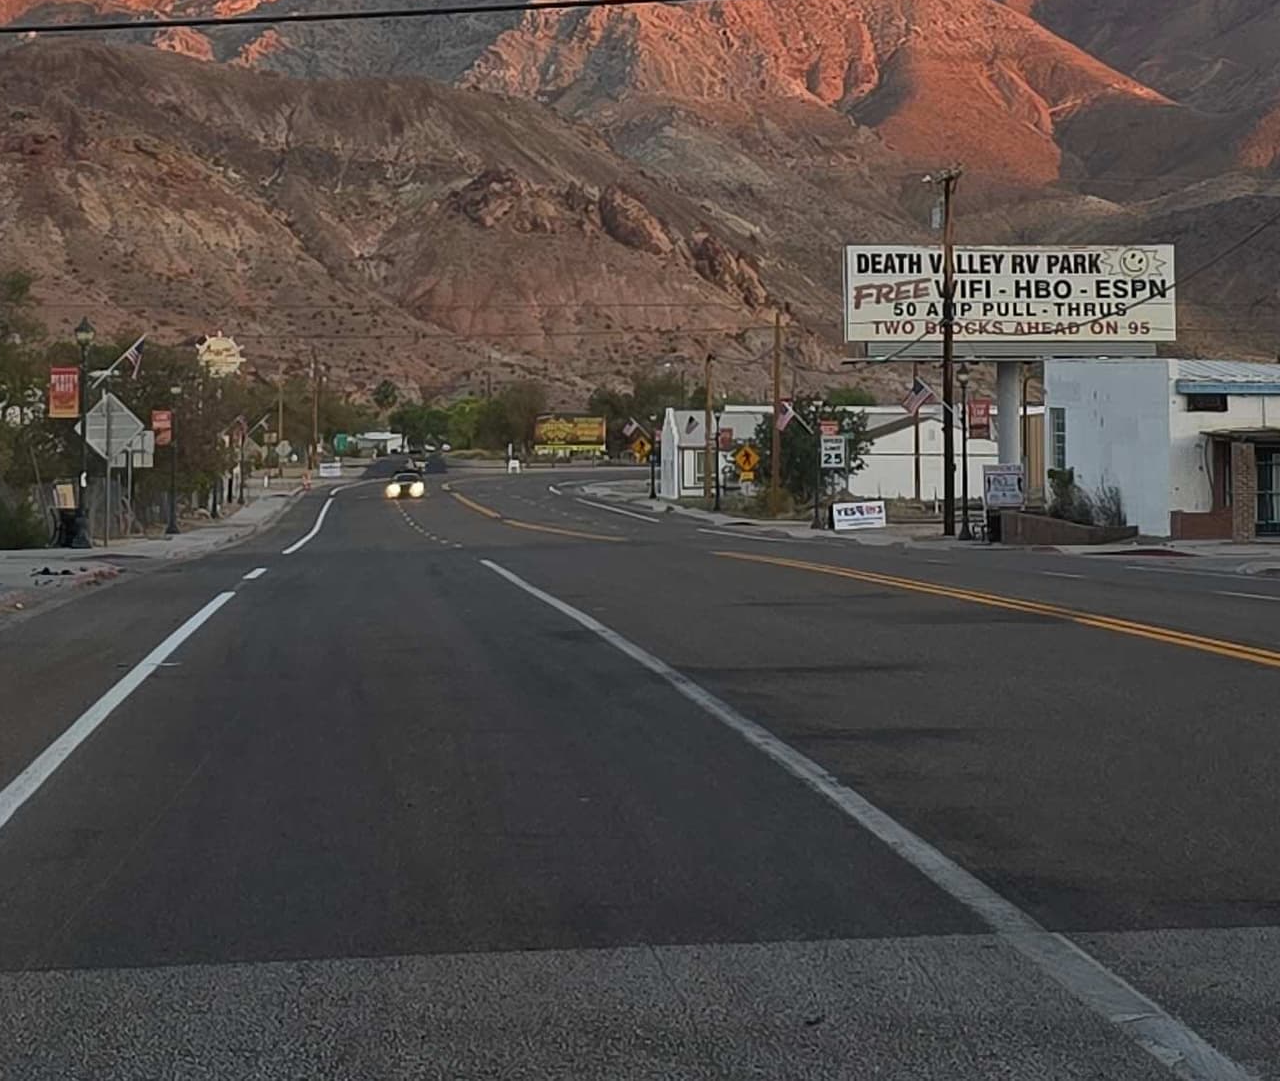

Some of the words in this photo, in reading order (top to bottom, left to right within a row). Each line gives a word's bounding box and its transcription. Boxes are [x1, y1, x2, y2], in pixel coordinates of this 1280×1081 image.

[856, 253, 922, 274] DEATH
[1012, 254, 1039, 274] RV
[1047, 253, 1102, 274] PARK
[853, 278, 932, 310] FREE
[1014, 279, 1072, 299] HBO
[1095, 279, 1167, 299] ESPN
[893, 302, 917, 317] 50
[982, 302, 1037, 317] PULL
[1054, 302, 1127, 317] THRUS
[873, 321, 915, 335] TWO
[1014, 321, 1081, 335] AHEAD
[1090, 321, 1118, 335] ON
[1128, 321, 1151, 335] 95
[823, 453, 843, 465] 25
